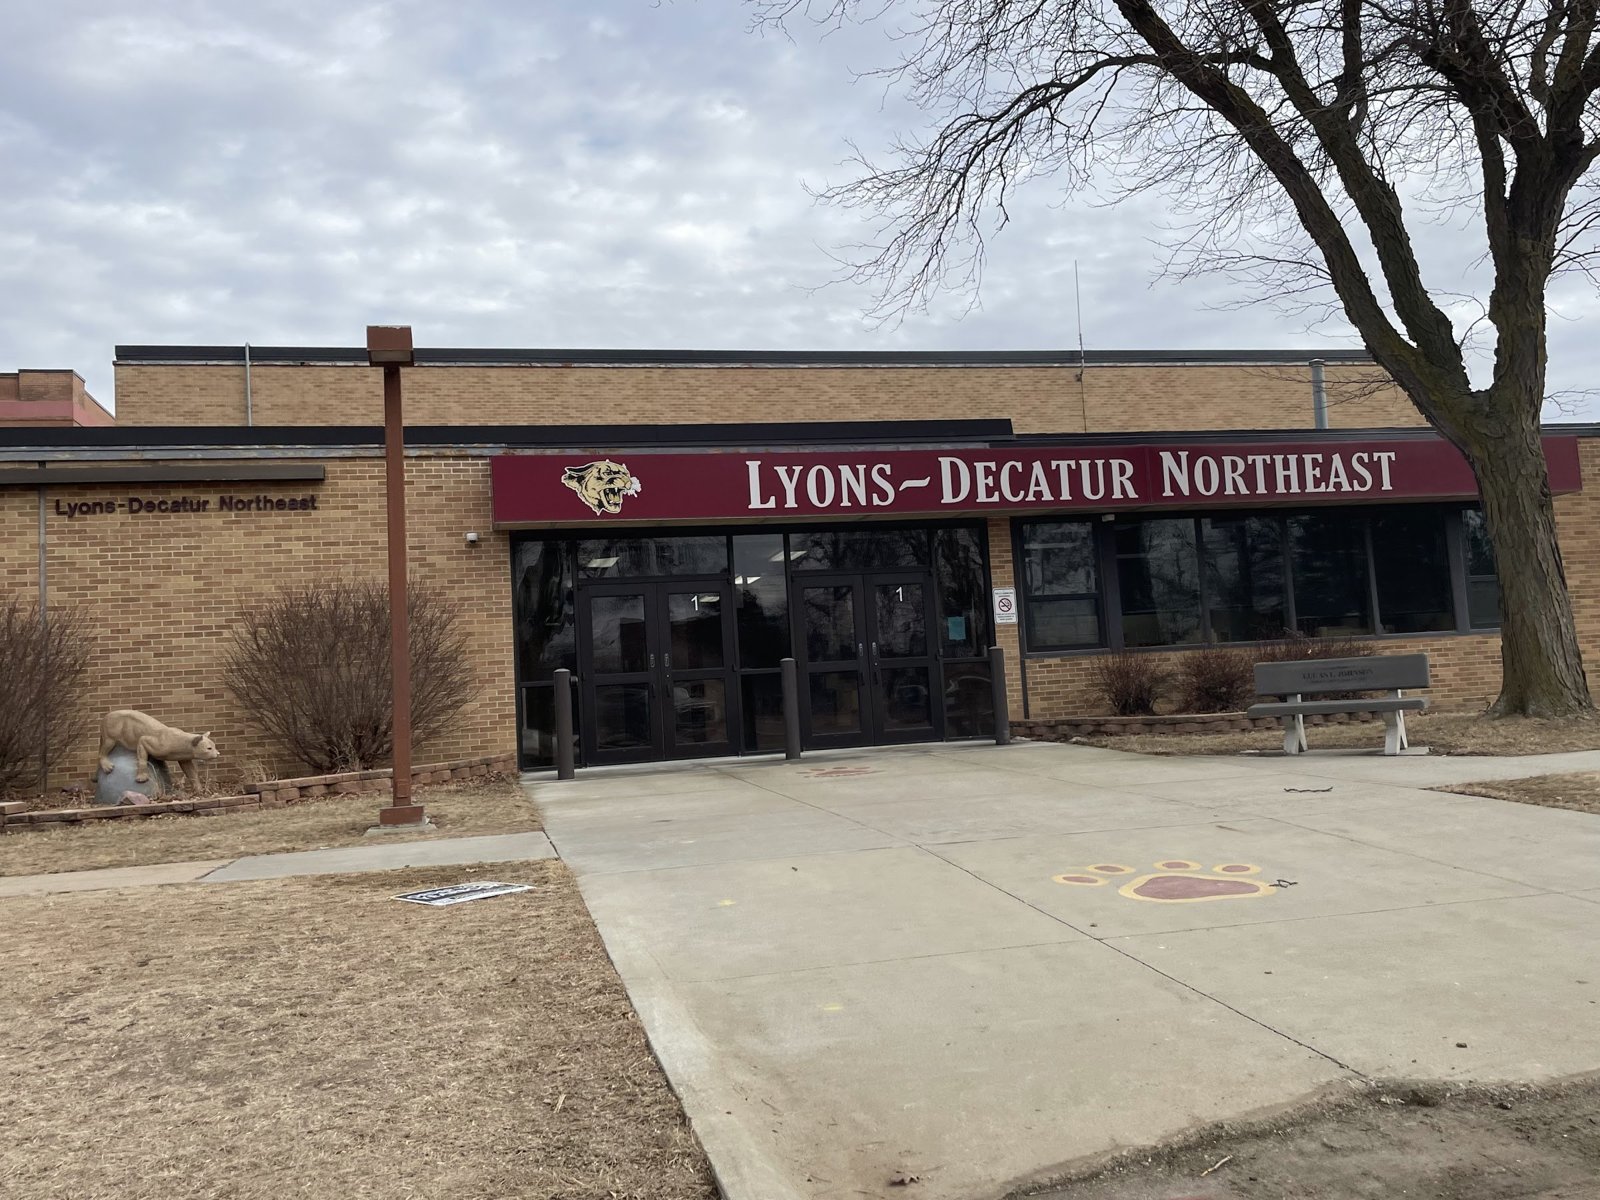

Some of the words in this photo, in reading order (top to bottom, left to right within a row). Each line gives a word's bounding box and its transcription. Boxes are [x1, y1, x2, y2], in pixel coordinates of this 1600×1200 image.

[1159, 451, 1396, 497] NORTHEAST
[55, 497, 209, 518] Lyons-Decatur
[219, 494, 318, 512] Northeast
[691, 595, 699, 611] 1
[896, 586, 903, 602] 1
